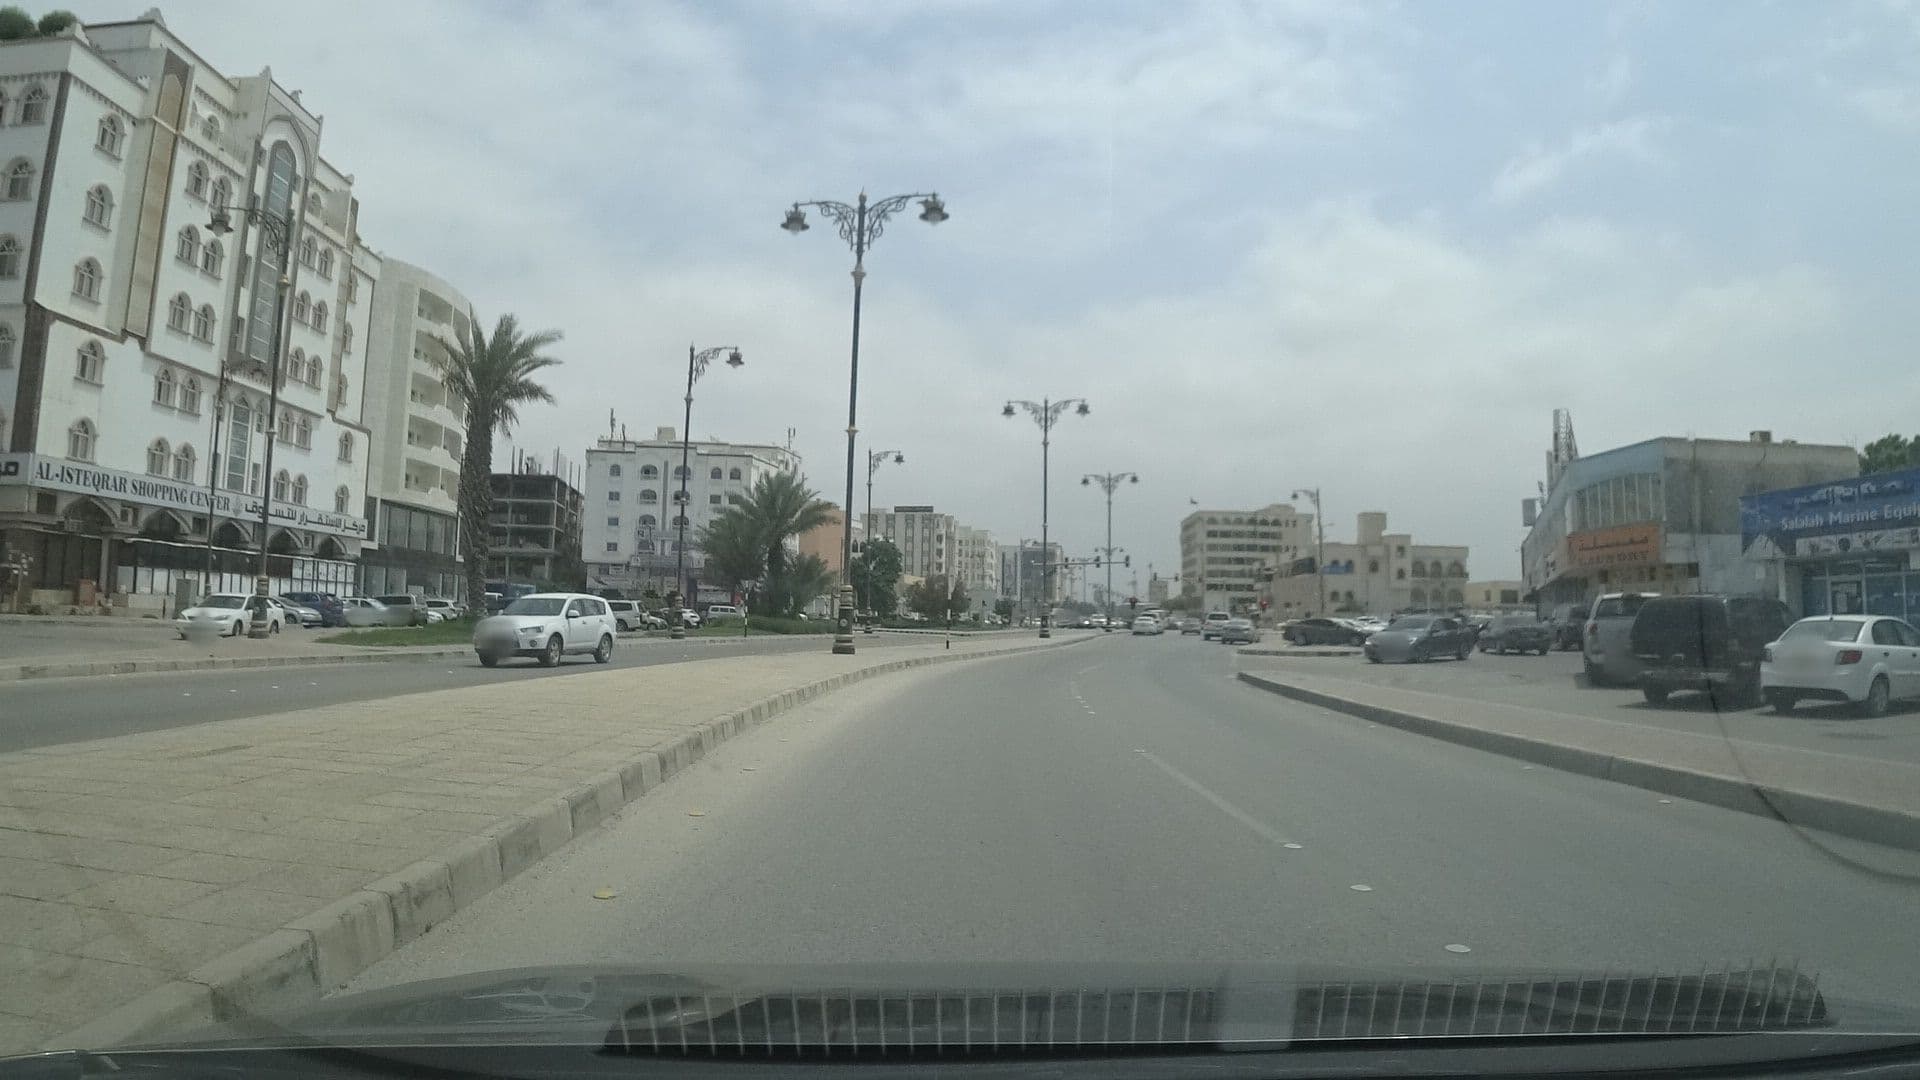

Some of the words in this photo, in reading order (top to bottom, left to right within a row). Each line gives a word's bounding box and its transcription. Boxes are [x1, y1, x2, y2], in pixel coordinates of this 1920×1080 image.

[130, 479, 187, 503] SHOPPING
[190, 490, 230, 511] CENER
[1829, 509, 1878, 525] Marine
[1884, 502, 1920, 520] Equi
